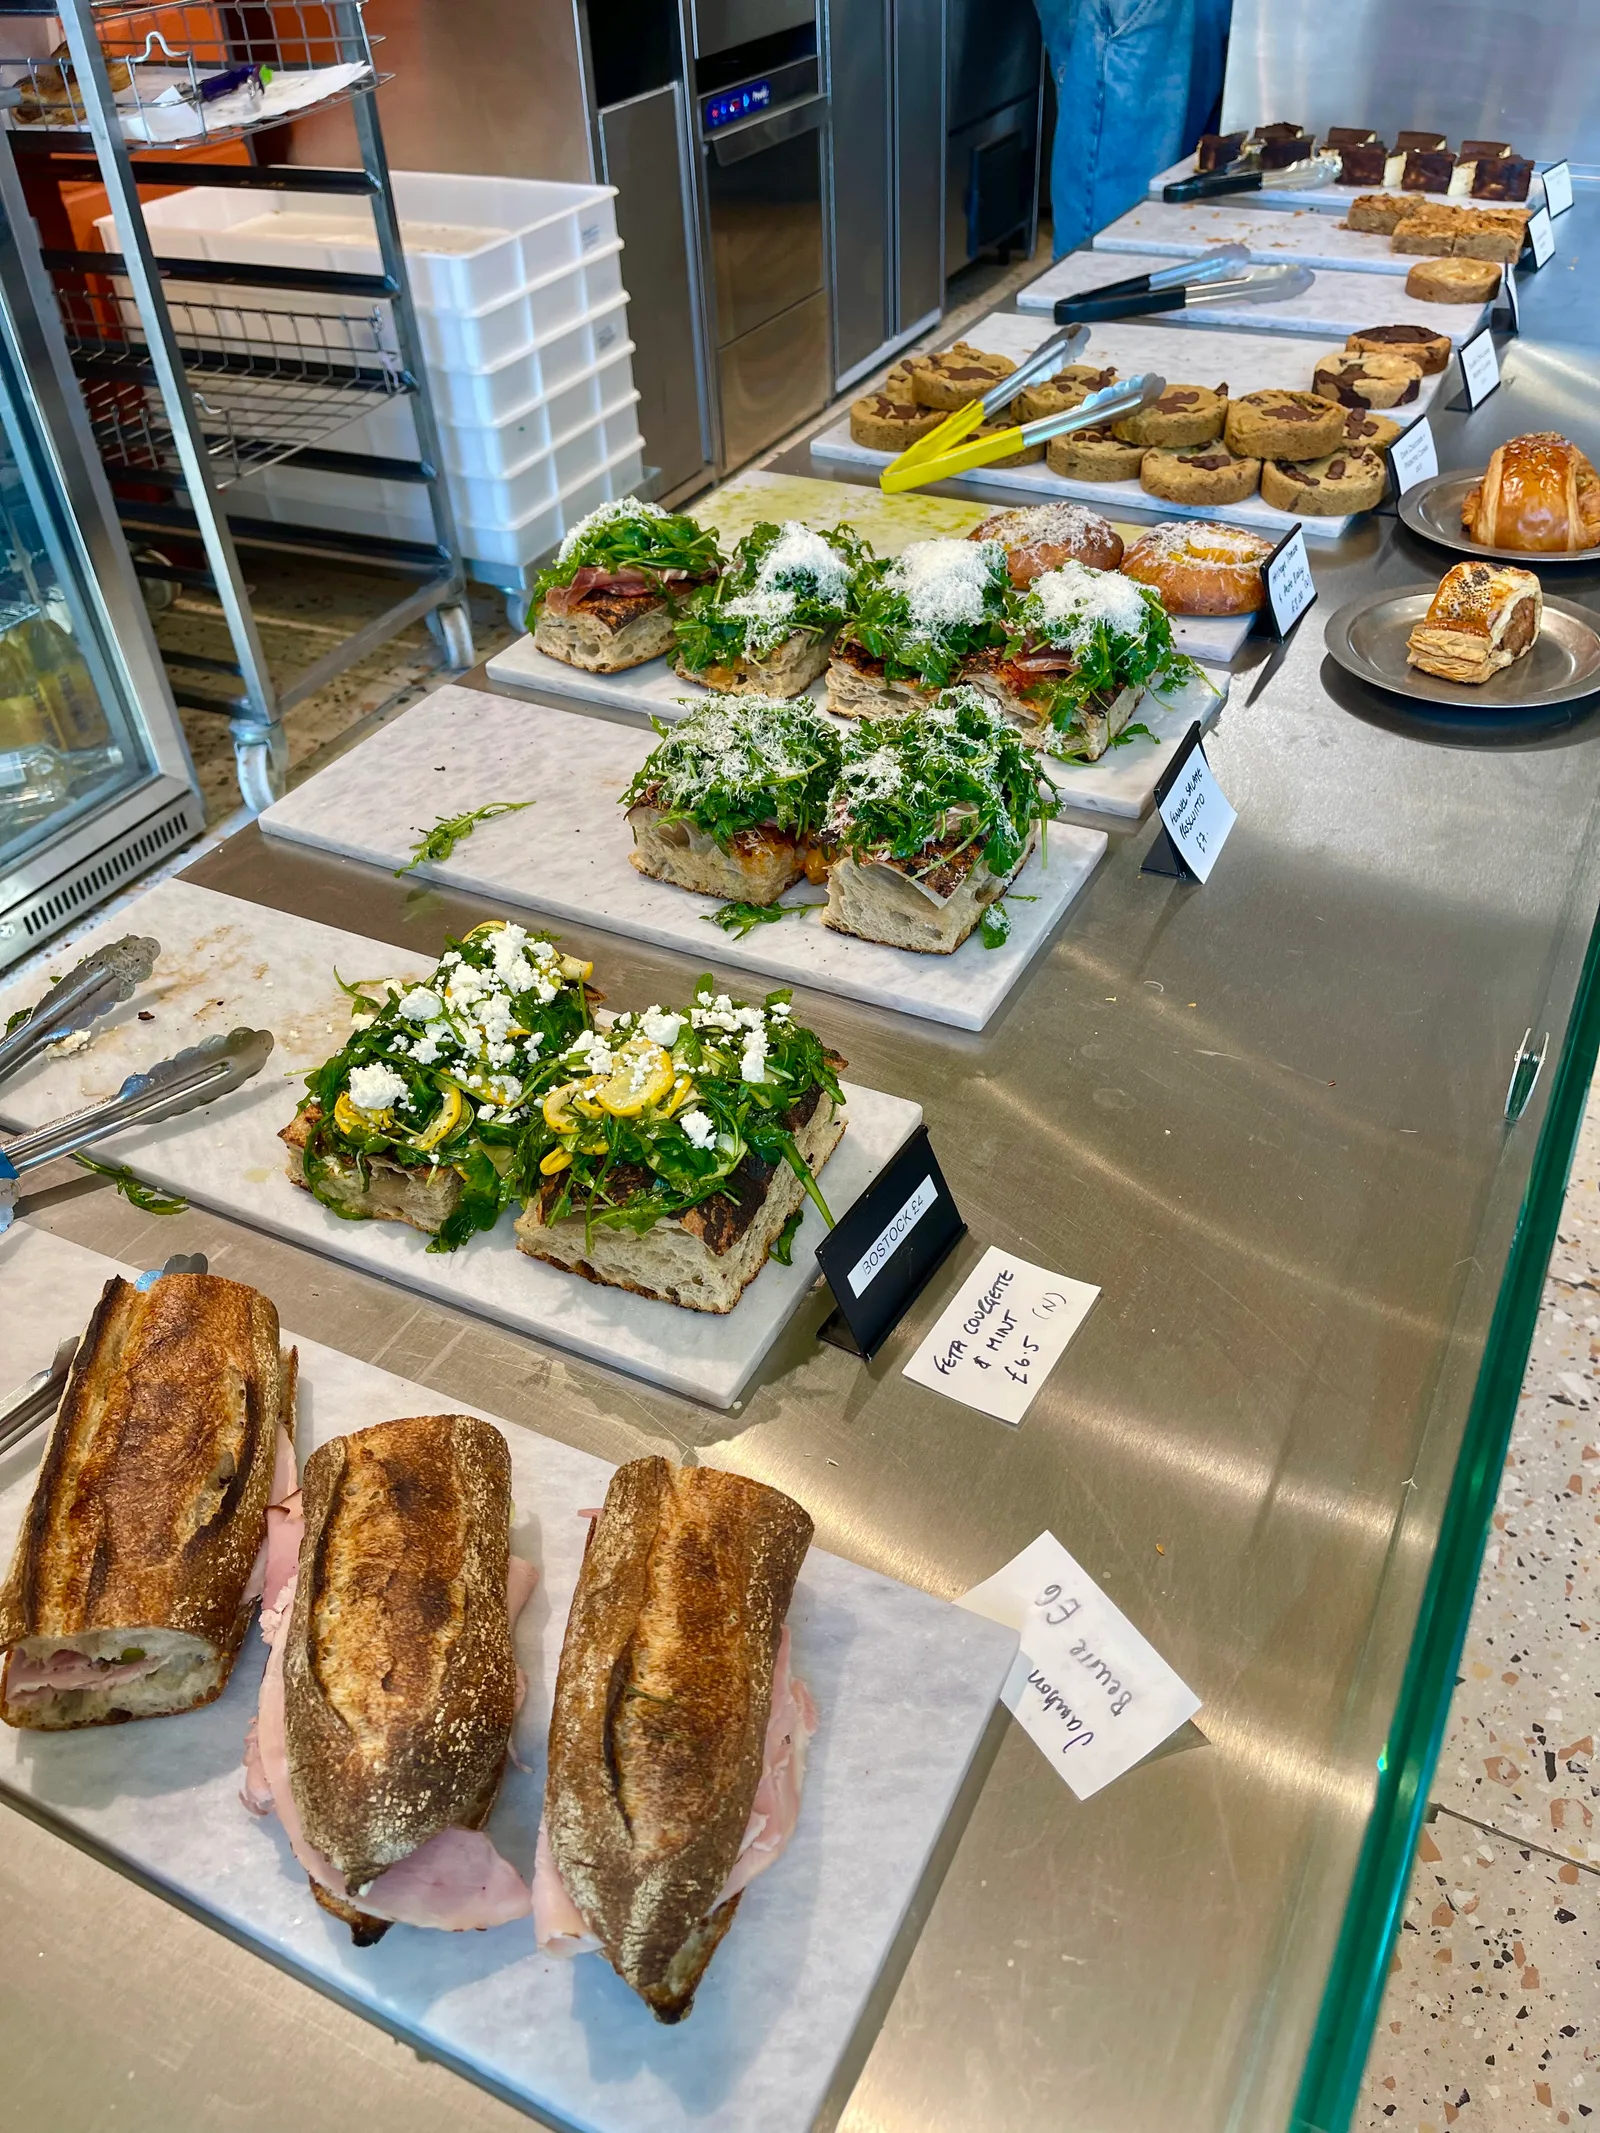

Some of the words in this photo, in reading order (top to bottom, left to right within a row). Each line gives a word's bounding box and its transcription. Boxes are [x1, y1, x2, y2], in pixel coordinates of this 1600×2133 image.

[861, 1212, 912, 1276] BOSTOCK
[911, 1194, 925, 1215] £4
[933, 1339, 968, 1375] FETA
[963, 1269, 1014, 1335] COURGETTE
[986, 1308, 1018, 1352] MINT
[1027, 1668, 1095, 1754] Jambon
[1069, 1638, 1134, 1717] Beurre
